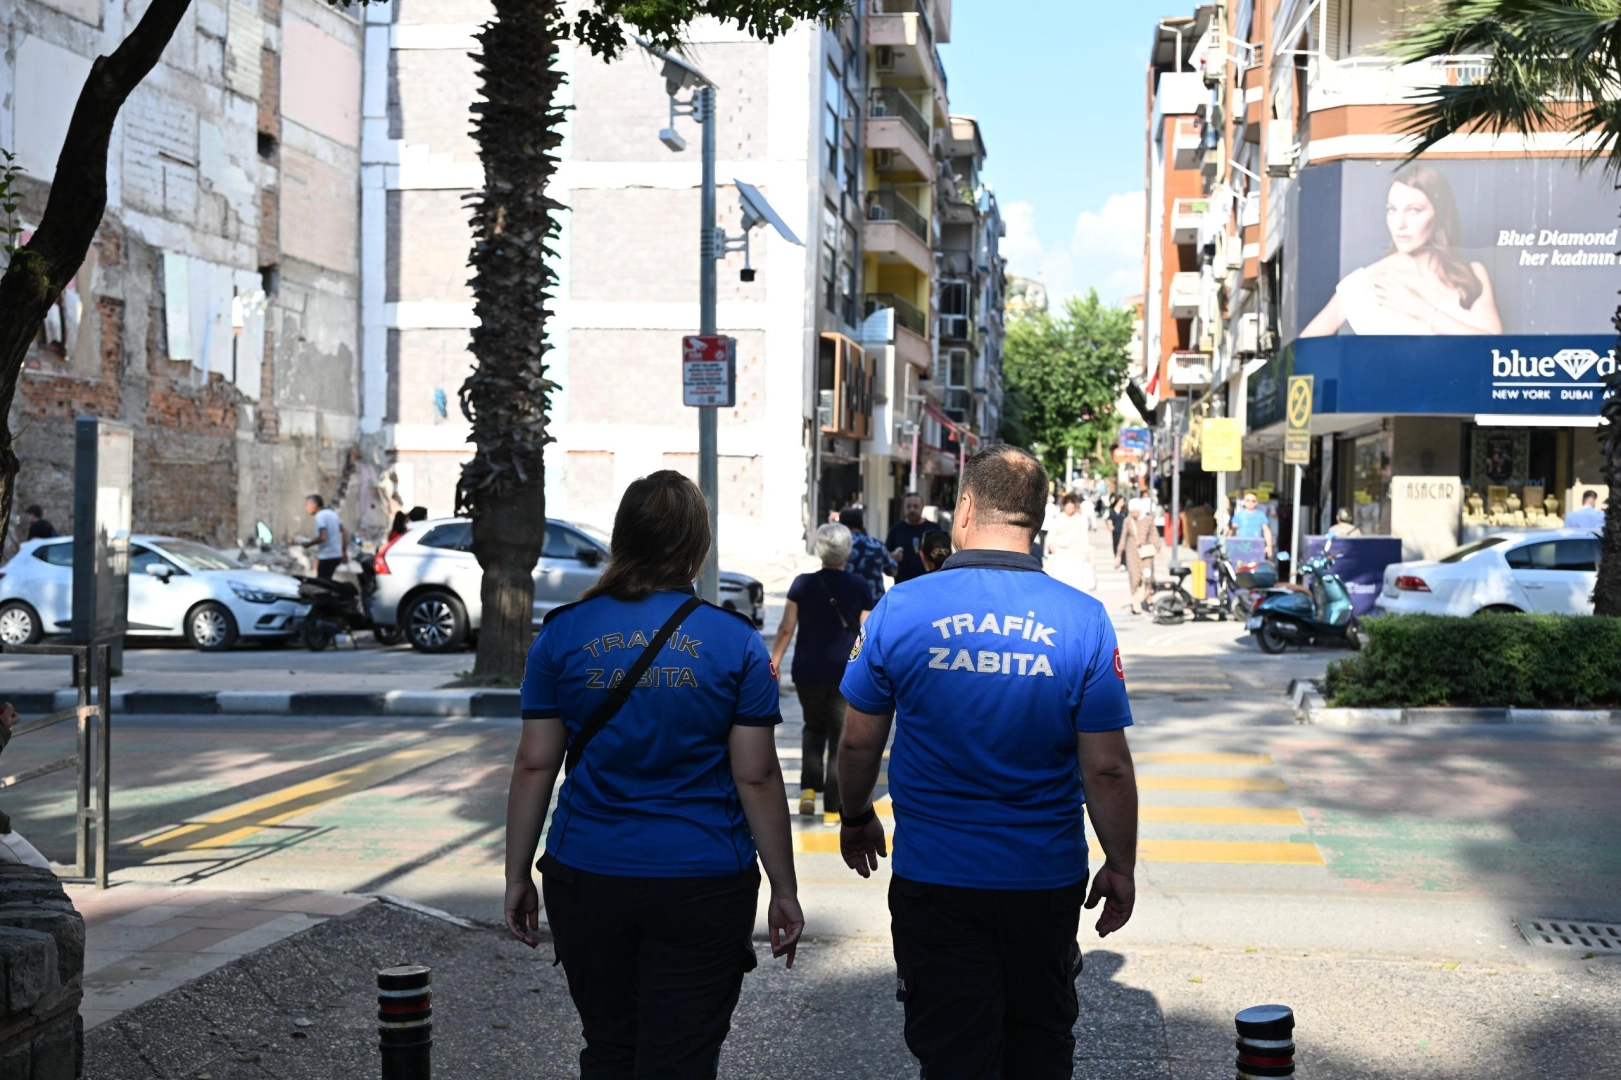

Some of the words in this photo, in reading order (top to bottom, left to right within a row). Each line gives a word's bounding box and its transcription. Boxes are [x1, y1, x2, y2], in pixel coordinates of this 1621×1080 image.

[1497, 229, 1535, 246] Blue
[1537, 229, 1618, 246] Diamond
[1519, 249, 1549, 266] her
[1551, 249, 1616, 266] kadının
[1491, 349, 1555, 377] blue
[1492, 389, 1519, 400] NEW
[1522, 389, 1551, 400] YORK
[1561, 389, 1593, 400] DUBAI
[583, 624, 702, 658] TRAİK
[928, 647, 1055, 677] ZABITA
